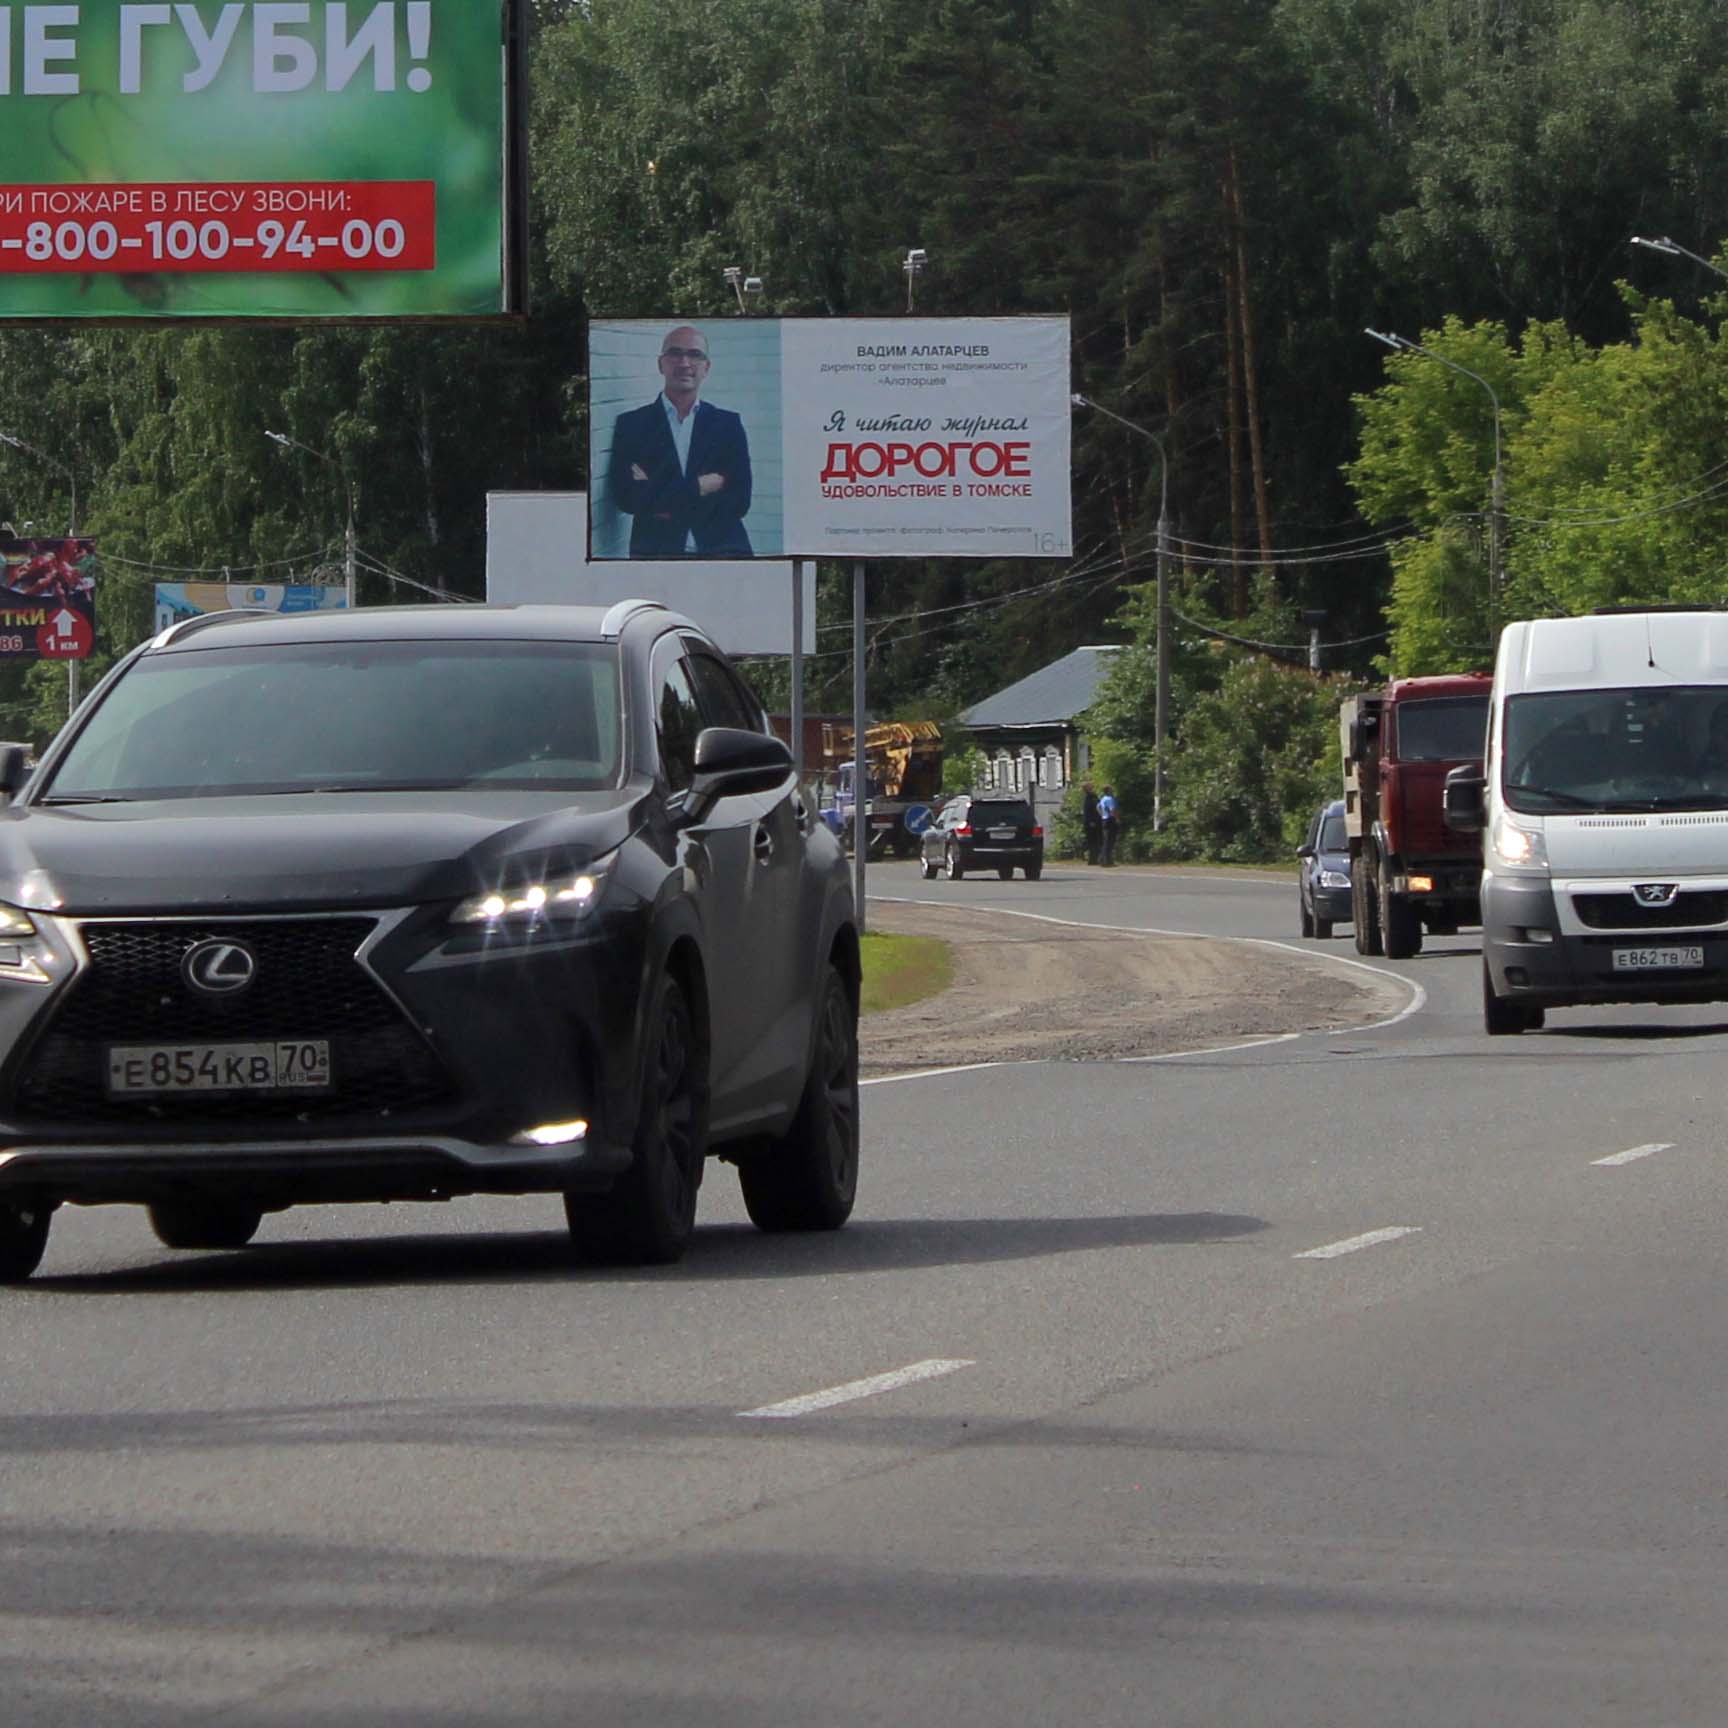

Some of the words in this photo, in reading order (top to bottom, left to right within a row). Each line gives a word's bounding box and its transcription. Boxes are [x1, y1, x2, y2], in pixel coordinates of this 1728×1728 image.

[119, 1, 432, 94] ГУБИ!
[30, 191, 142, 213] ПОЖАРЕ
[151, 191, 167, 212] В
[174, 190, 244, 212] ЛЕСУ
[252, 189, 351, 212] ЗВОНИ:
[857, 345, 906, 357] ВАДИМ
[912, 345, 989, 357] АЛАТАРЦЕВ
[820, 362, 876, 373] директор
[880, 362, 938, 372] агентства
[823, 410, 846, 432] Я
[856, 414, 932, 432] читаю
[941, 415, 1029, 437] журнал
[820, 441, 1031, 483] ДОРОГОЕ
[822, 484, 946, 499] УДОВОЛЬСТВИЕ
[953, 484, 963, 497] В
[968, 483, 1032, 497] ТОМСКЕ
[1034, 532, 1069, 553] 16+
[45, 635, 56, 651] 1
[1683, 948, 1698, 960] 70
[280, 1045, 318, 1075] 70
